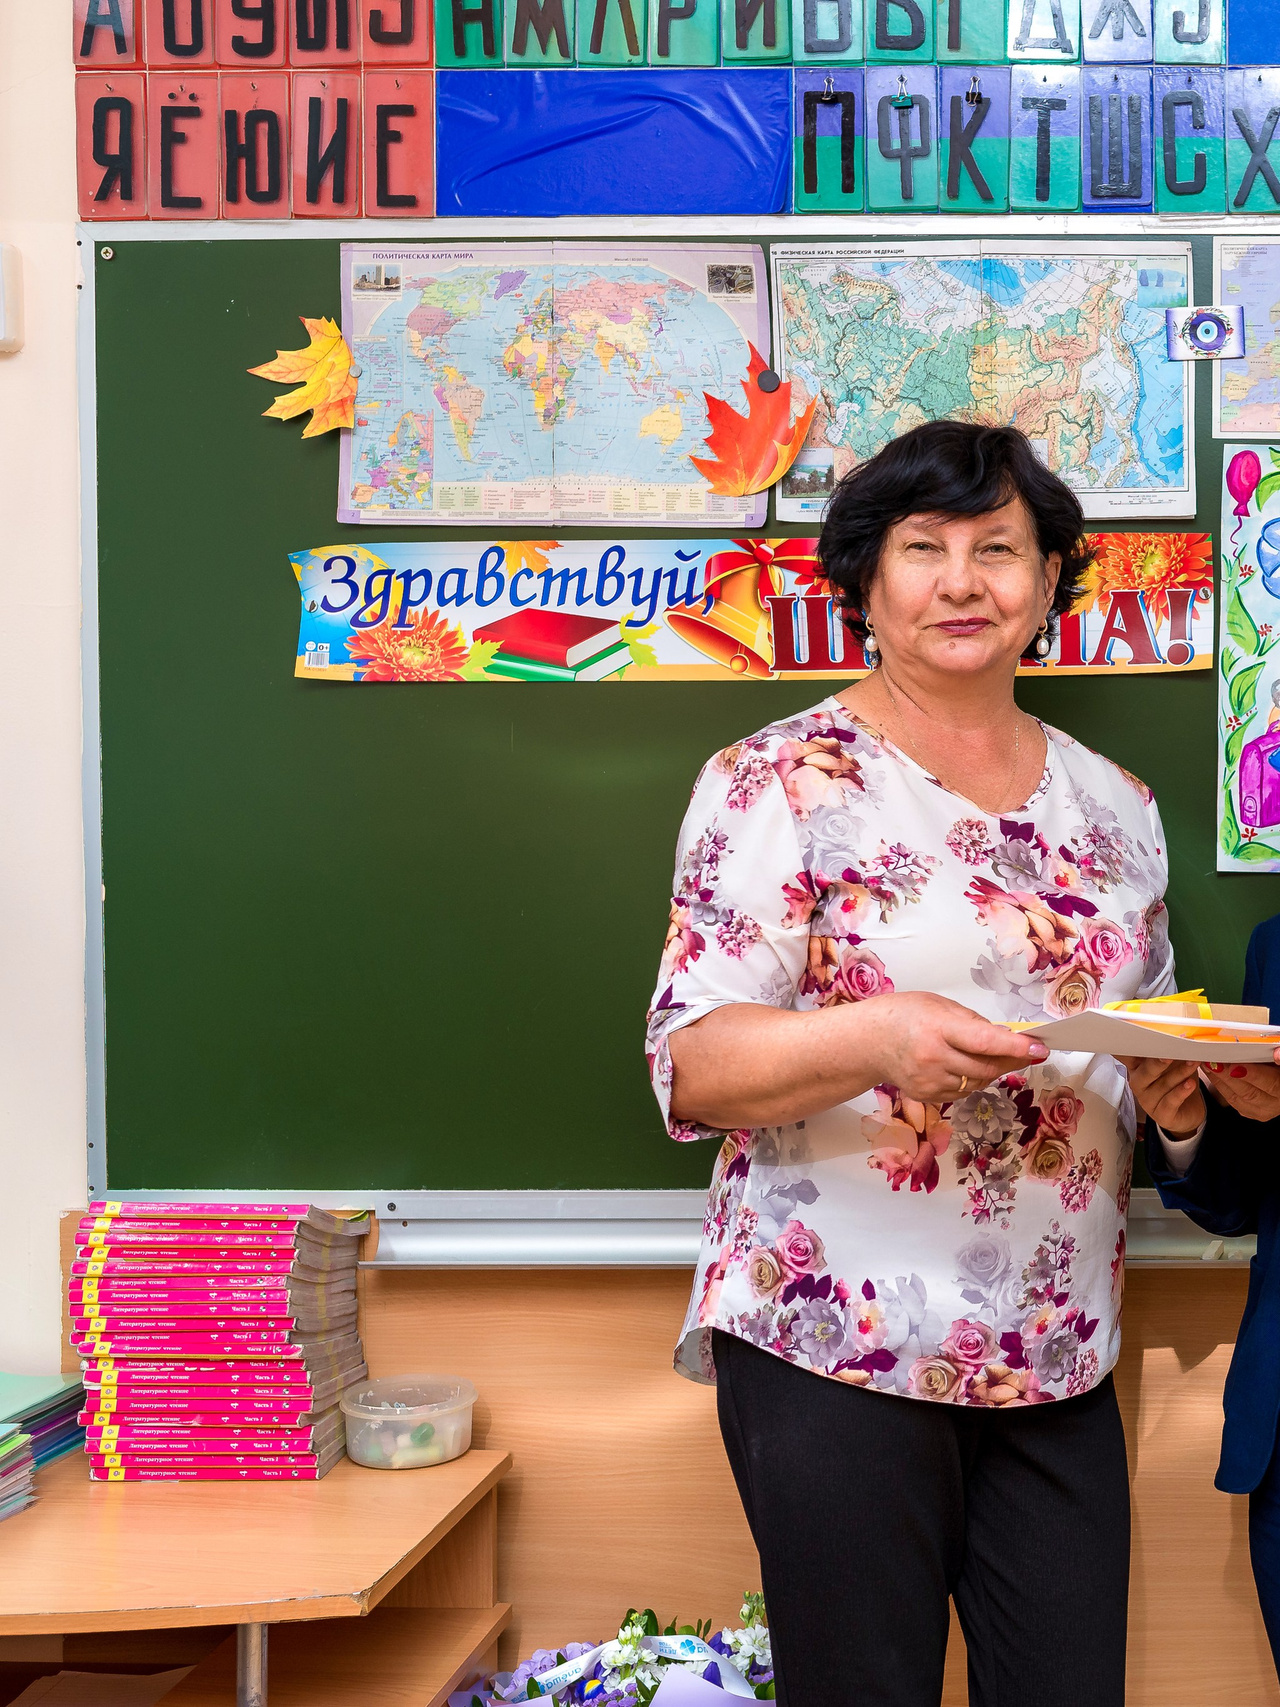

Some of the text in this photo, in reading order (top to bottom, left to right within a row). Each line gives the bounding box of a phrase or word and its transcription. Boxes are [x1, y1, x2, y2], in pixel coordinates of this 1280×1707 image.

[93, 96, 133, 202] Я
[161, 92, 203, 208] Ё
[225, 109, 280, 203] Ю
[306, 97, 348, 204] И
[376, 105, 417, 207] Е
[803, 91, 855, 194] П
[877, 95, 931, 200] Ф
[947, 95, 994, 200] К
[1022, 97, 1067, 201] Т
[1089, 94, 1143, 198] Ш
[1162, 90, 1207, 194] С
[320, 545, 714, 630] Здравствуй,
